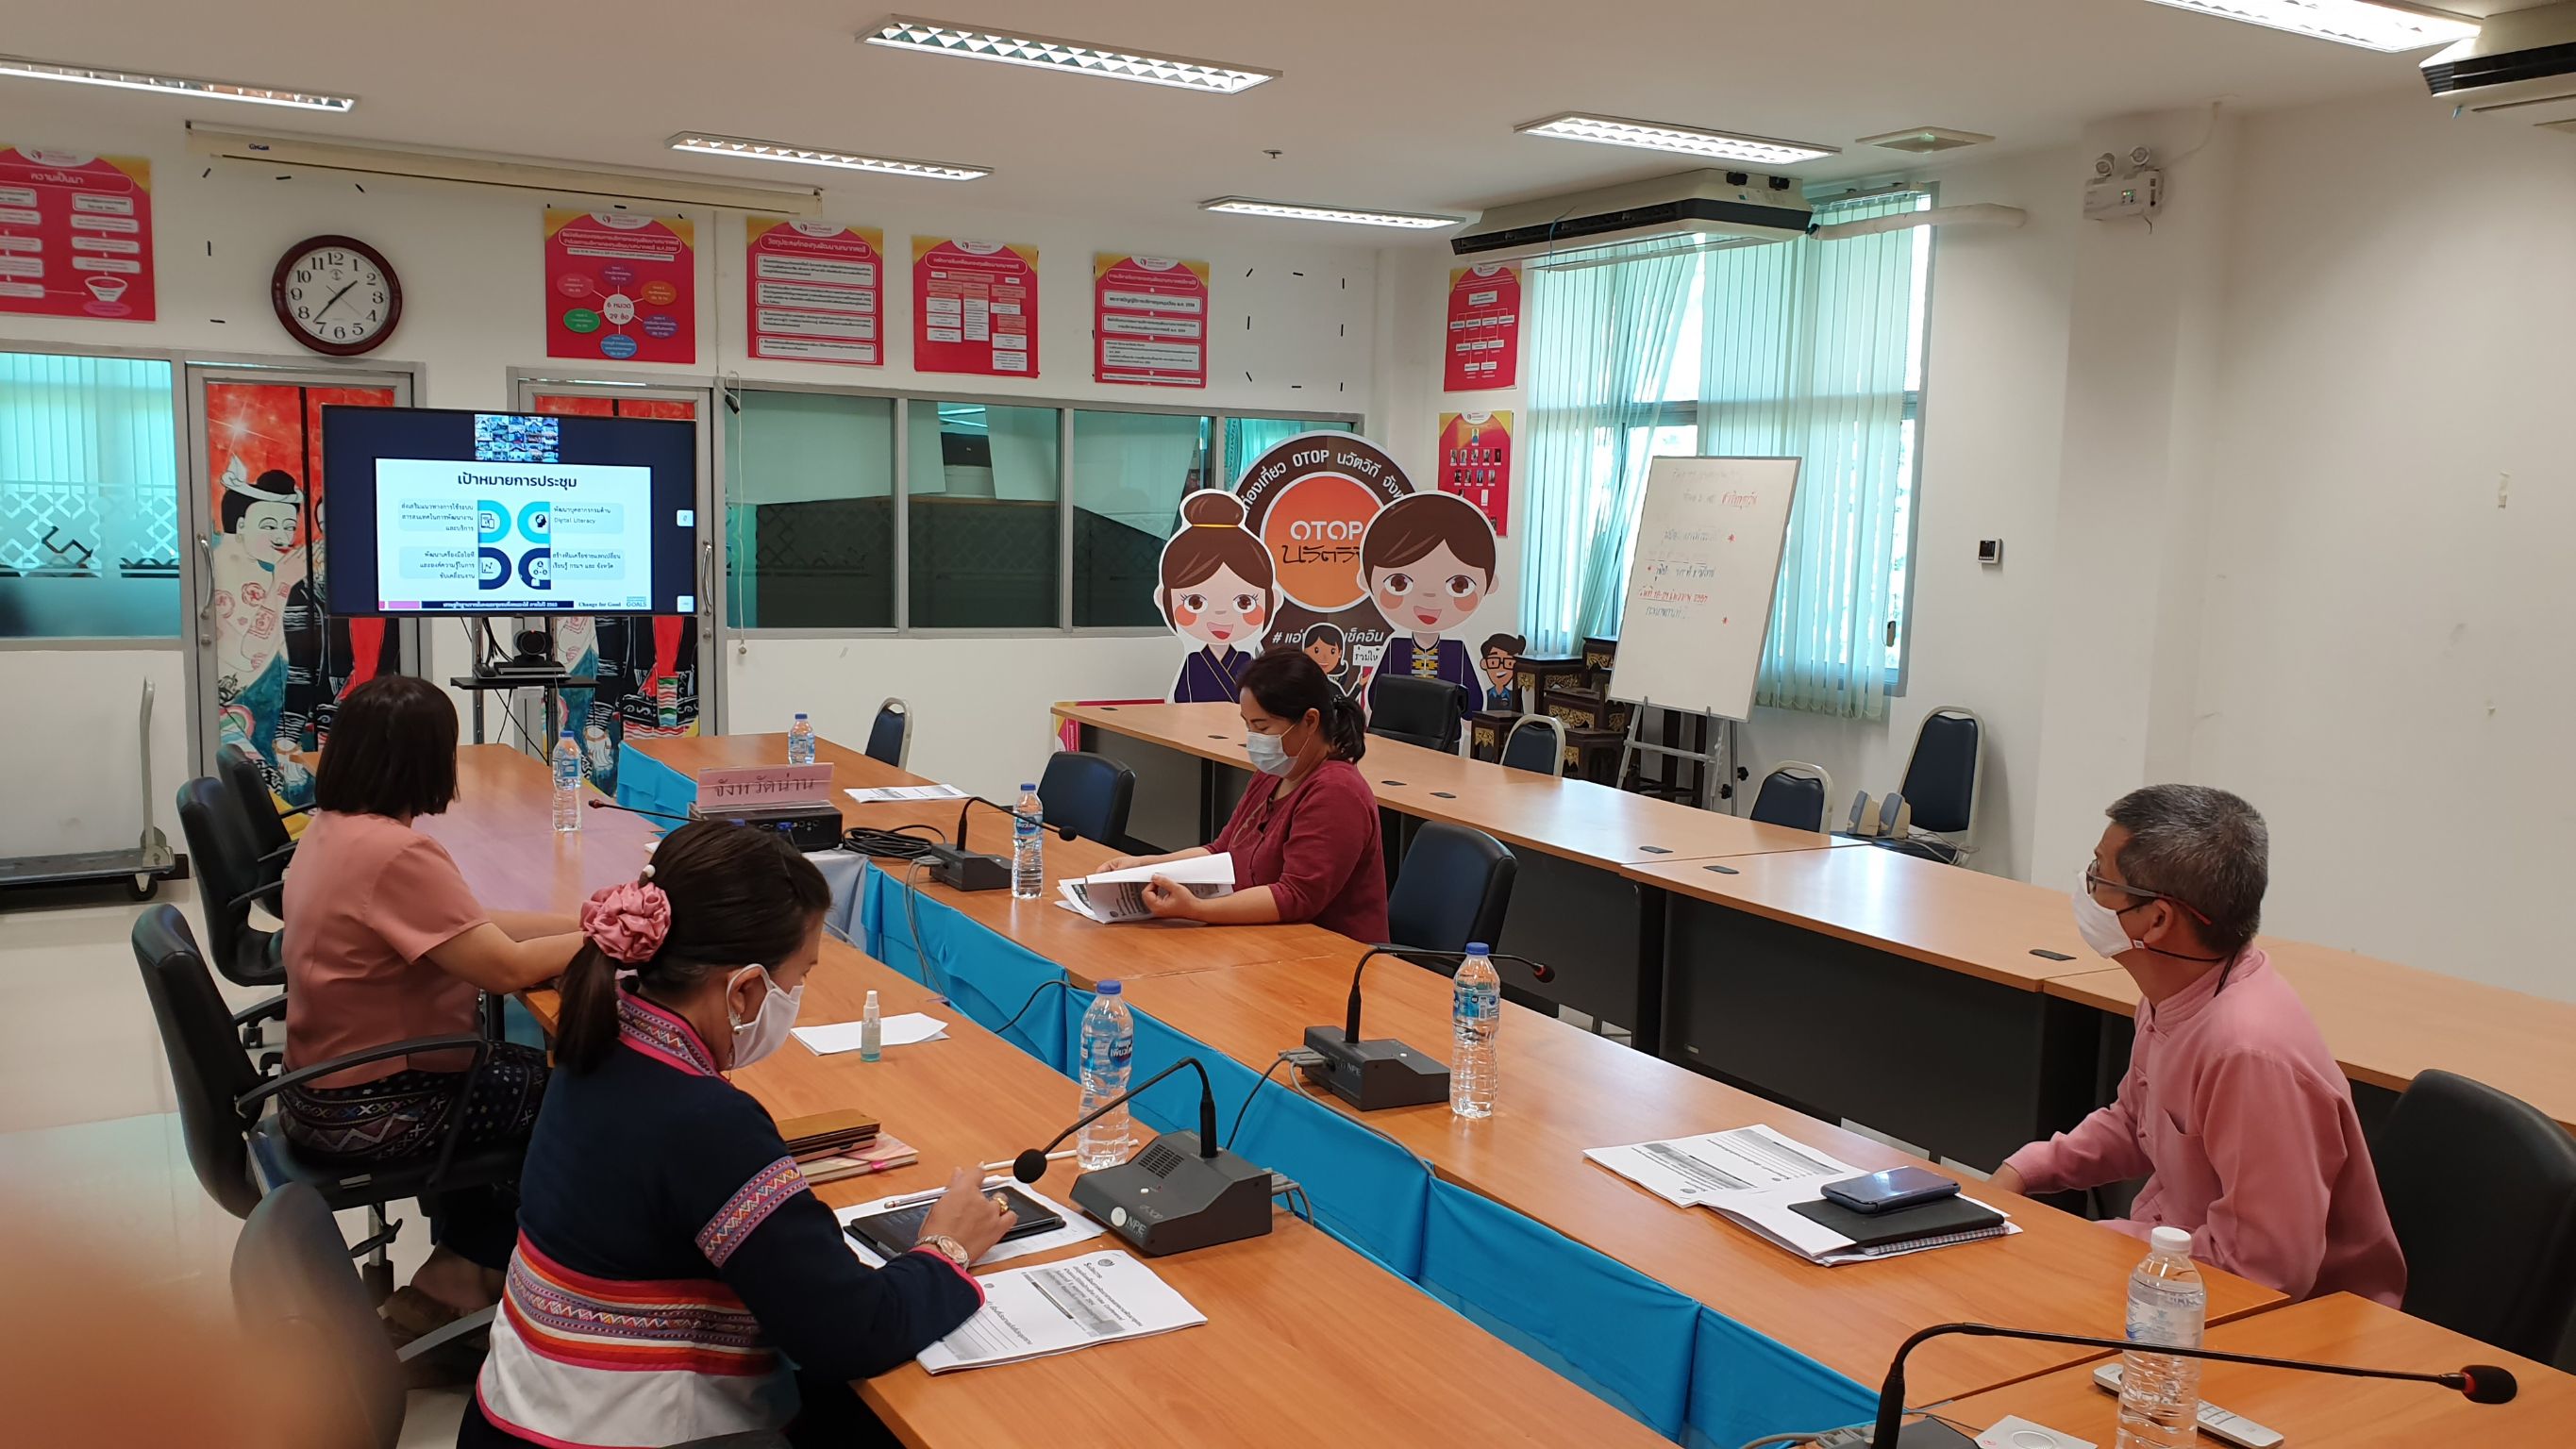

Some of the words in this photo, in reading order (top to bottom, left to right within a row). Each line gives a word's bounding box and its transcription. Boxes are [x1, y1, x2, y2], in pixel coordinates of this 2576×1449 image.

[311, 257, 324, 270] 11
[327, 252, 343, 265] 12
[353, 258, 359, 272] 1
[297, 270, 311, 283] 10
[366, 273, 376, 286] 2
[291, 288, 302, 301] 9
[372, 291, 384, 304] 3
[298, 306, 309, 319] 8
[366, 309, 376, 322] 4
[315, 322, 326, 334] 7
[334, 326, 345, 339] 6
[352, 323, 363, 336] 5
[1292, 449, 1330, 468] OTOP
[1336, 451, 1382, 478] นวัตวิถี
[457, 472, 577, 491] เป้าหมายการประชุม
[1290, 520, 1363, 541] OTOP
[713, 772, 815, 797] จังหวัดน่าน
[1126, 1215, 1146, 1236] NPE
